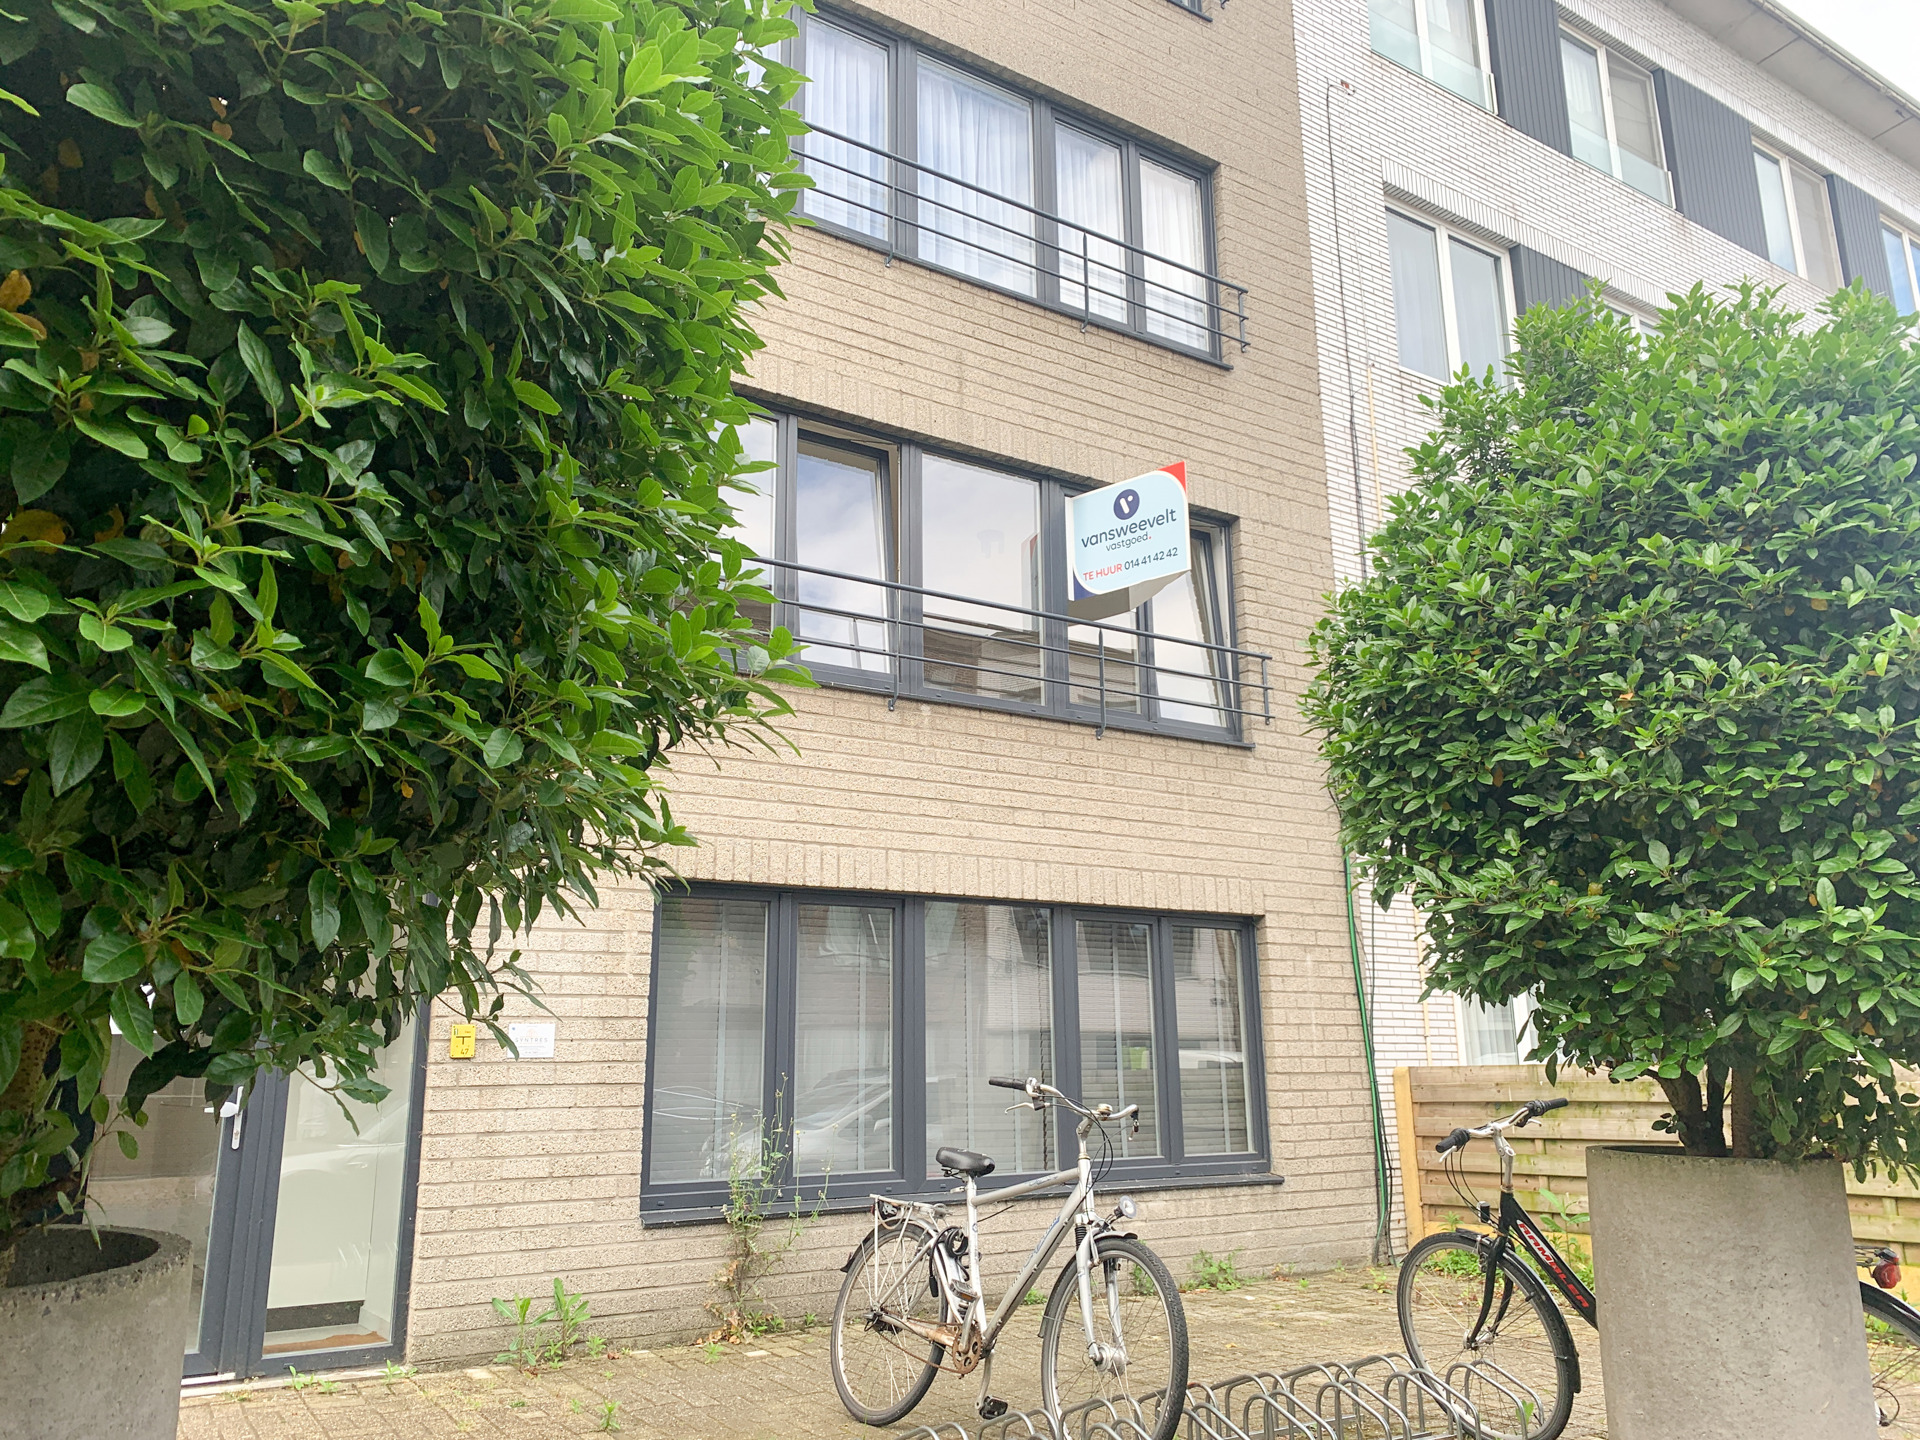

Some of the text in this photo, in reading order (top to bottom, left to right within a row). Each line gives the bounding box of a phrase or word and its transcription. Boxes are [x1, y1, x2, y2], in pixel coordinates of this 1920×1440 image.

[1081, 508, 1177, 547] vansweevelt
[1083, 571, 1094, 582] TE
[1096, 563, 1123, 578] HUUR
[1518, 1223, 1589, 1307] RAMBLER
